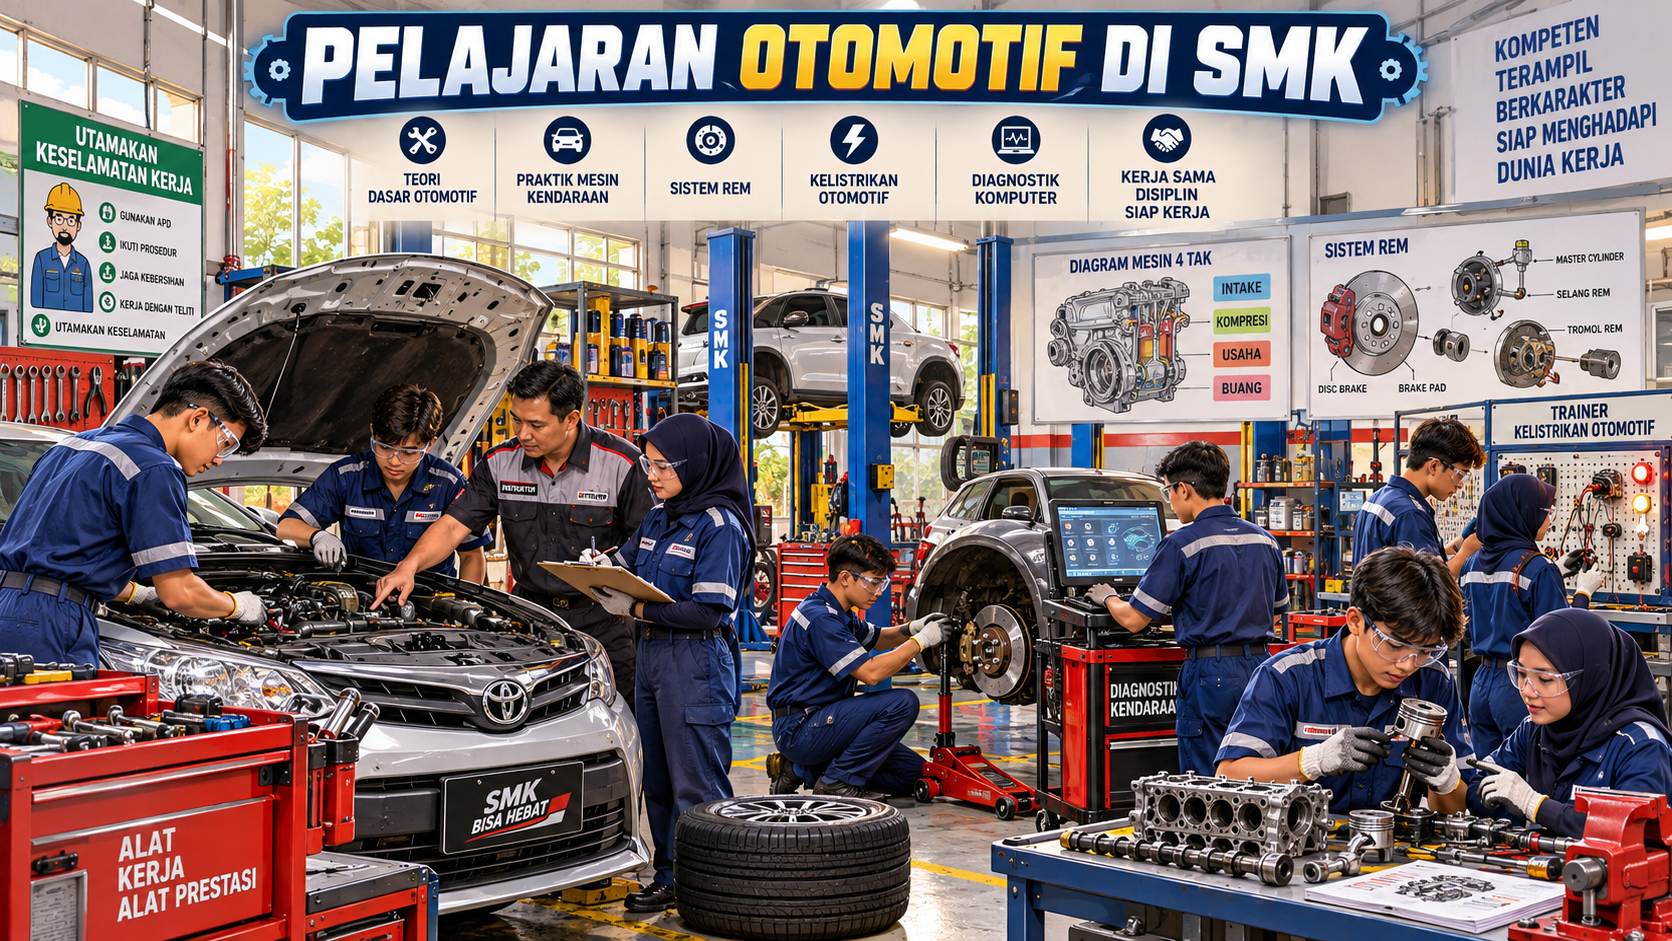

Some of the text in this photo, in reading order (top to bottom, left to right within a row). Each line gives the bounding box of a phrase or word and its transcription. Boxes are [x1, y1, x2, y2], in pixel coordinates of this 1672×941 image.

[1496, 14, 1599, 62] KOMPETEN
[1496, 50, 1593, 92] TERAMPIL
[1497, 75, 1626, 123] BERKARAKTER
[1497, 102, 1656, 153] SIAP MENGHADAPI
[76, 125, 158, 164] UTAMAKAN
[36, 142, 192, 195] KESELAMATAN KERJA
[1498, 142, 1624, 184] DUNIA KERJA
[120, 211, 171, 228] GUNAKAN APD
[120, 240, 177, 257] IKUTI PROSEDUR
[1325, 238, 1408, 258] SISTEM REM
[1070, 251, 1211, 273] DIAGRAM MESIN 4 TAK
[1556, 252, 1624, 264] MASTER CYLINDER
[120, 270, 184, 286] JAGA KEBERSIHAN
[1222, 282, 1261, 294] INTAKE
[1557, 288, 1610, 298] SELANG REM
[120, 300, 194, 316] KERJA DENGAN TELITI
[1217, 314, 1267, 328] KOMPRESI
[1568, 324, 1622, 334] TROMOL REM
[56, 322, 165, 340] UTAMAKAN KESELAMATAN
[714, 310, 728, 368] SMK
[870, 303, 885, 365] SMK
[1223, 348, 1261, 360] USAHA
[1222, 382, 1261, 394] BUANG
[1318, 384, 1367, 393] DISC BRAKE
[1399, 383, 1446, 392] BRAKE PAD
[1551, 404, 1608, 420] TRAINER
[1515, 420, 1655, 439] KELISTRIKAN OTOMOTIF
[1111, 700, 1176, 717] KENDARAA
[484, 778, 542, 814] SMK
[471, 799, 550, 836] BISA HEBAT
[119, 827, 176, 862] ALAT
[119, 855, 185, 891] KERJA
[118, 887, 170, 922] ALAT
[175, 867, 256, 907] PRESTASI
